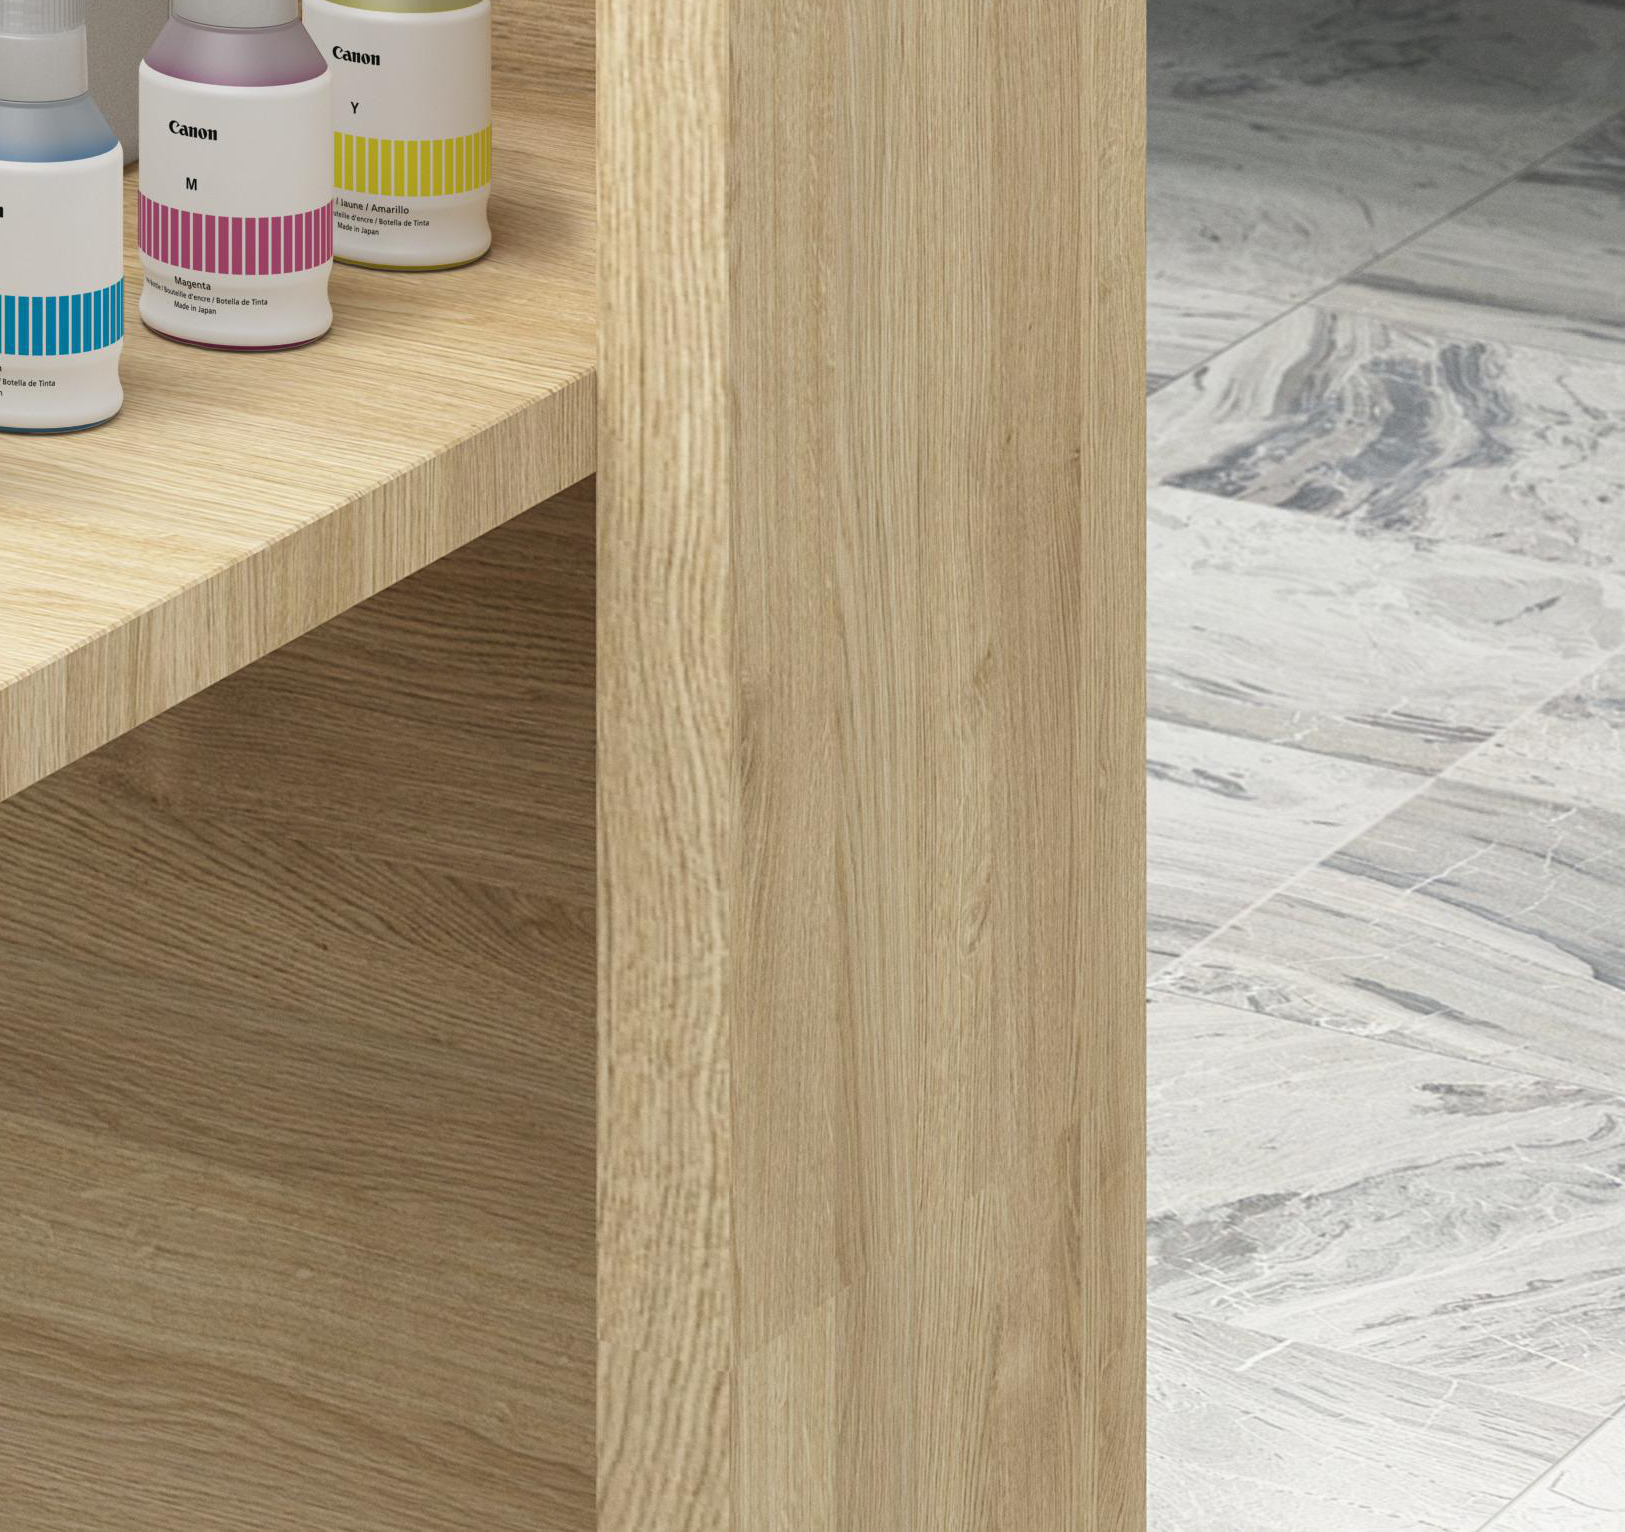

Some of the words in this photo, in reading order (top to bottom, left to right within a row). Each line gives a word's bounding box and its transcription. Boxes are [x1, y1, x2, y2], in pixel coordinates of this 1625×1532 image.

[332, 45, 381, 66] Canon
[350, 101, 359, 115] Y
[168, 119, 218, 141] Canon
[185, 176, 198, 191] M
[340, 198, 363, 212] Jaune
[371, 203, 410, 215] Amarillo
[337, 221, 352, 233] Made
[353, 226, 360, 234] in
[360, 226, 380, 236] Japan
[174, 276, 211, 291] Magenta
[174, 300, 189, 311] Made
[190, 304, 197, 313] in
[197, 306, 217, 316] Japan
